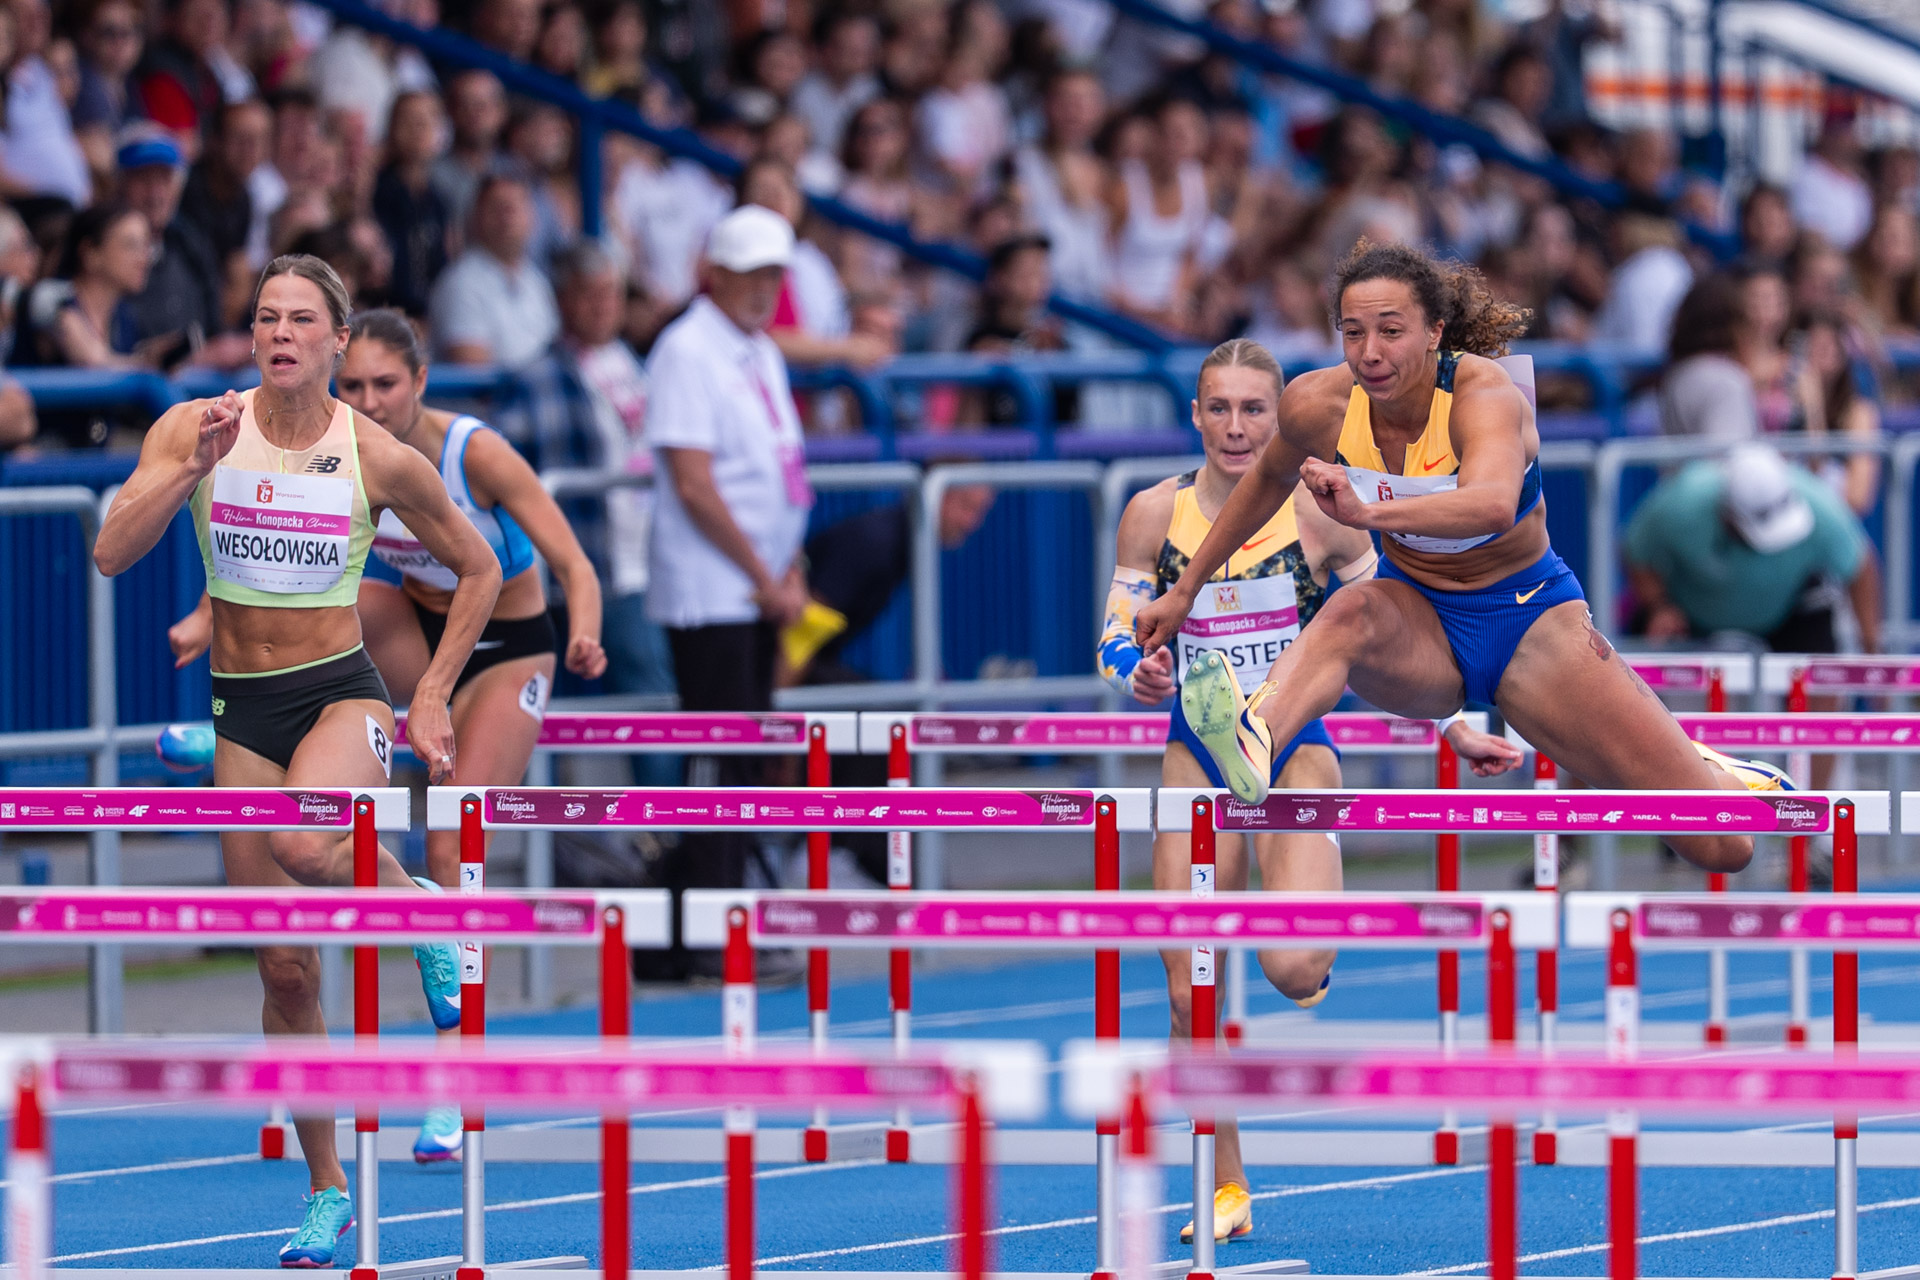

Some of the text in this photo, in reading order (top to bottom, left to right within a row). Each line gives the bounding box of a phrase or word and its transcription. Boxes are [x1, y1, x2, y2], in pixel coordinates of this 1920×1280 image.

[222, 509, 339, 529] Halina Konopacka Classic
[215, 530, 339, 566] WESOŁOWSKA
[1208, 617, 1256, 633] Konopacka
[1258, 615, 1289, 626] Classic
[374, 726, 386, 764] 8
[128, 805, 150, 818] 4F
[300, 803, 338, 814] Konopacka
[497, 801, 535, 812] Konopacka
[868, 806, 891, 818] 4F
[1041, 803, 1080, 814] Konopacka
[1227, 806, 1266, 818] Konopacka
[1602, 811, 1624, 823] 4F
[1776, 809, 1816, 819] Konopacka
